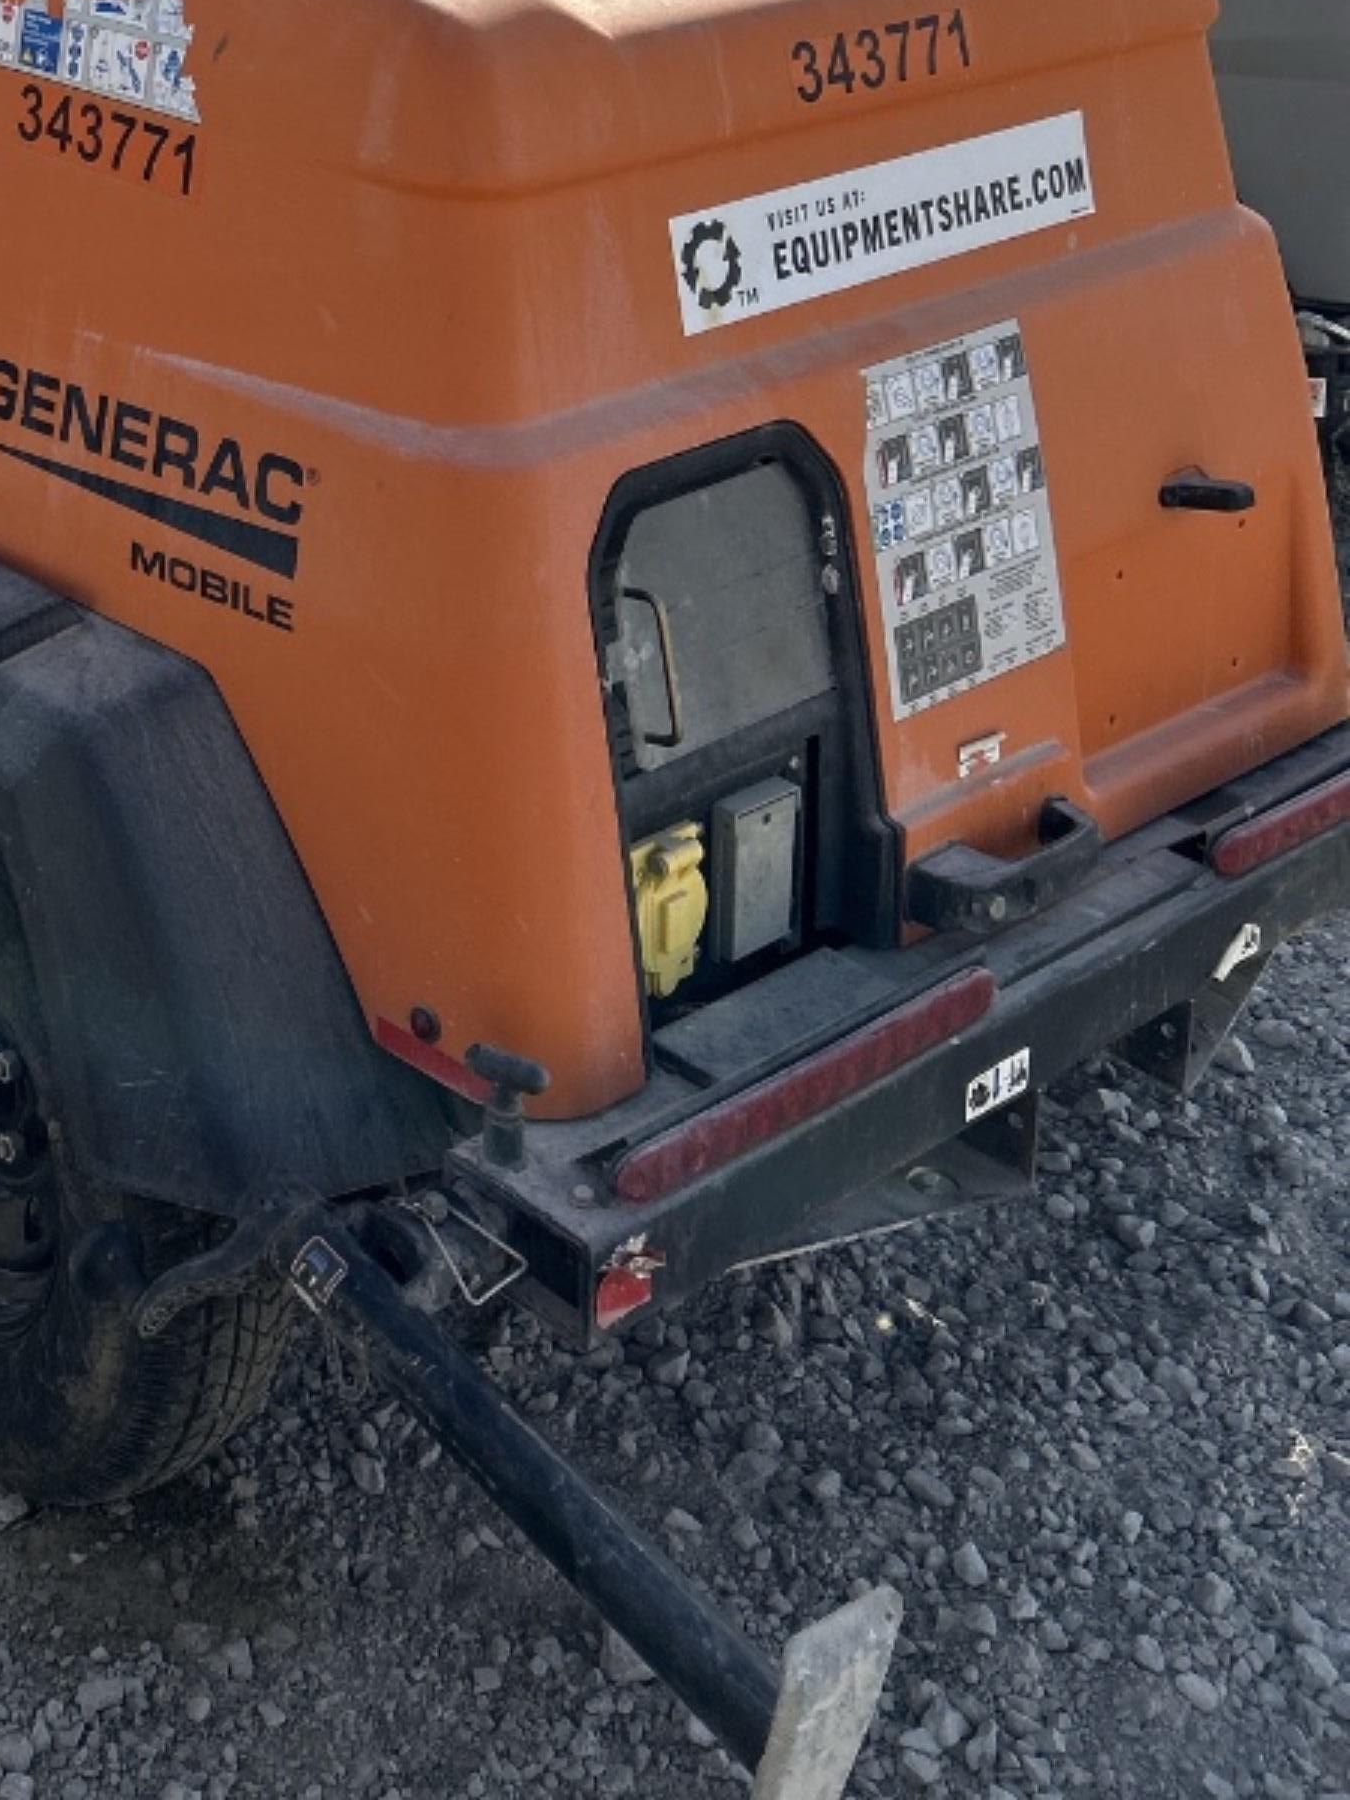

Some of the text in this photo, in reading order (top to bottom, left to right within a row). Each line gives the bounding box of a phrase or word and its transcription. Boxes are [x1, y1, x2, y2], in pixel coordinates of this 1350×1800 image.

[791, 8, 971, 103] 343771
[17, 83, 196, 196] 343771
[766, 188, 866, 232] VISIT US AT:
[772, 156, 1088, 281] EQUIPMENTSHARE.COM
[130, 541, 294, 632] MOBILE
